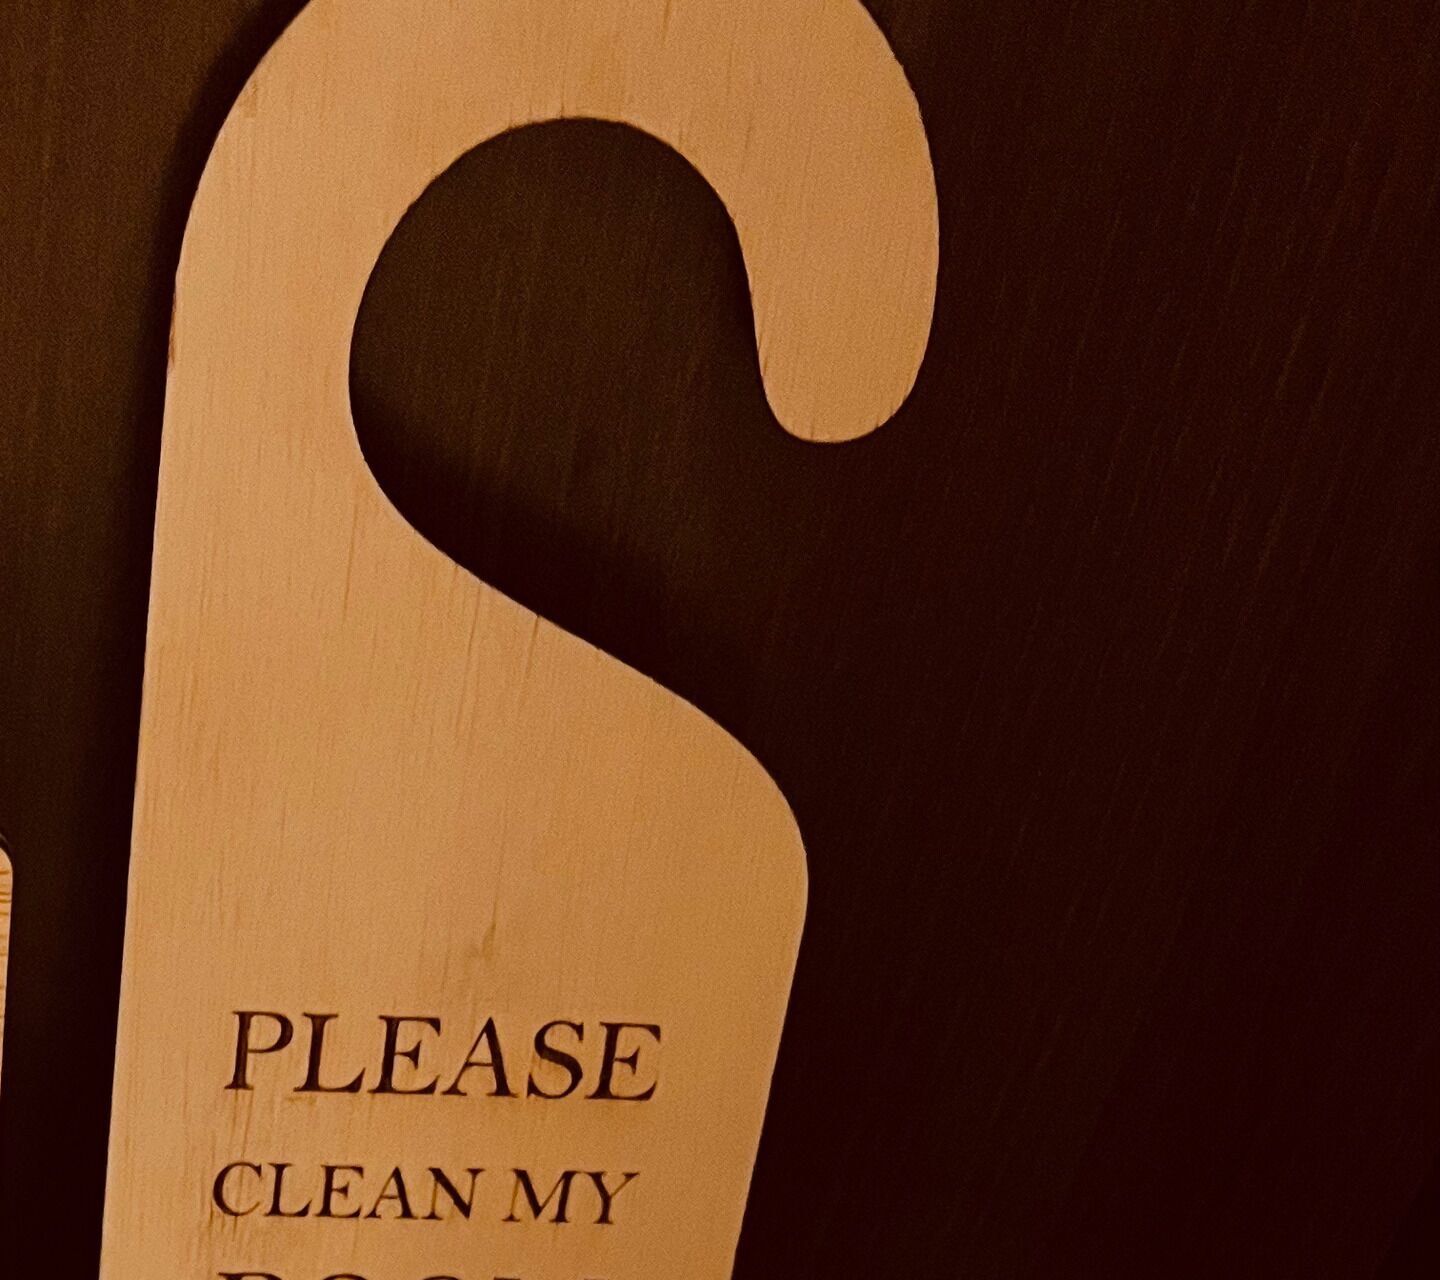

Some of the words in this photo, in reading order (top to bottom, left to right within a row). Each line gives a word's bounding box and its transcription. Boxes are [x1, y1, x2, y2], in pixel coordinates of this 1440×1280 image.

[223, 1010, 662, 1101] PLEASE
[212, 1162, 485, 1222] CLEAN
[502, 1168, 640, 1225] MY
